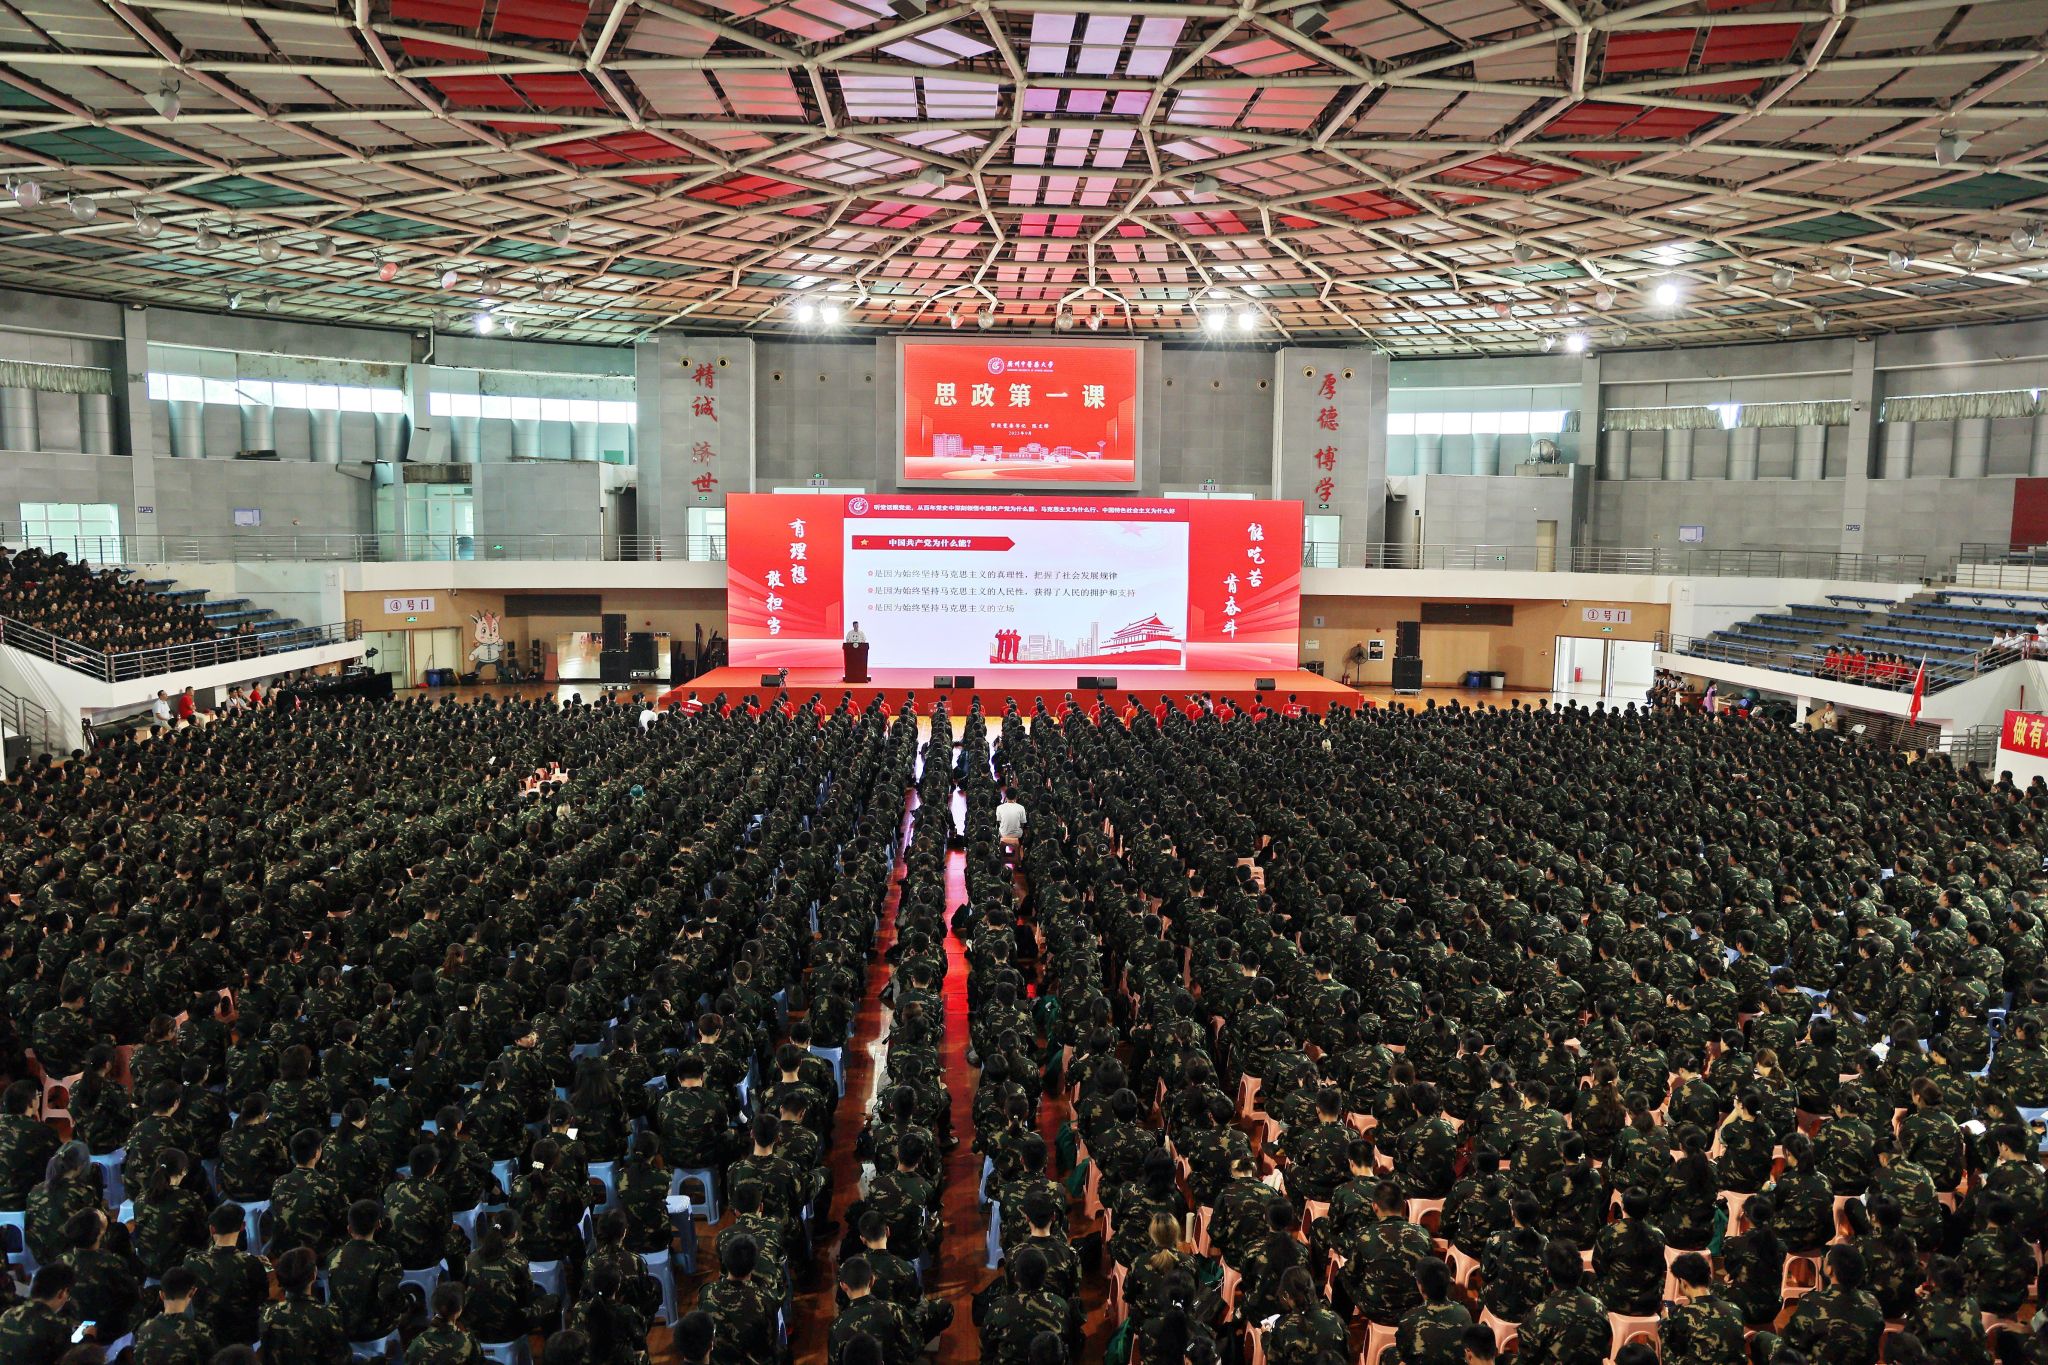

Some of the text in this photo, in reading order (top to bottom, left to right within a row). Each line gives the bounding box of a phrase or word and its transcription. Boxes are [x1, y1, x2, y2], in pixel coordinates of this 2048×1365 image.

[934, 382, 1106, 409] 思政第一课
[788, 517, 808, 584] 有理想
[1246, 522, 1266, 587] 能吃苦
[765, 569, 785, 635] 敢担当
[875, 603, 1015, 613] 是因为始终坚持马克思主义的立场
[1221, 572, 1242, 640] 肯奋斗
[2012, 715, 2048, 750] 做有
